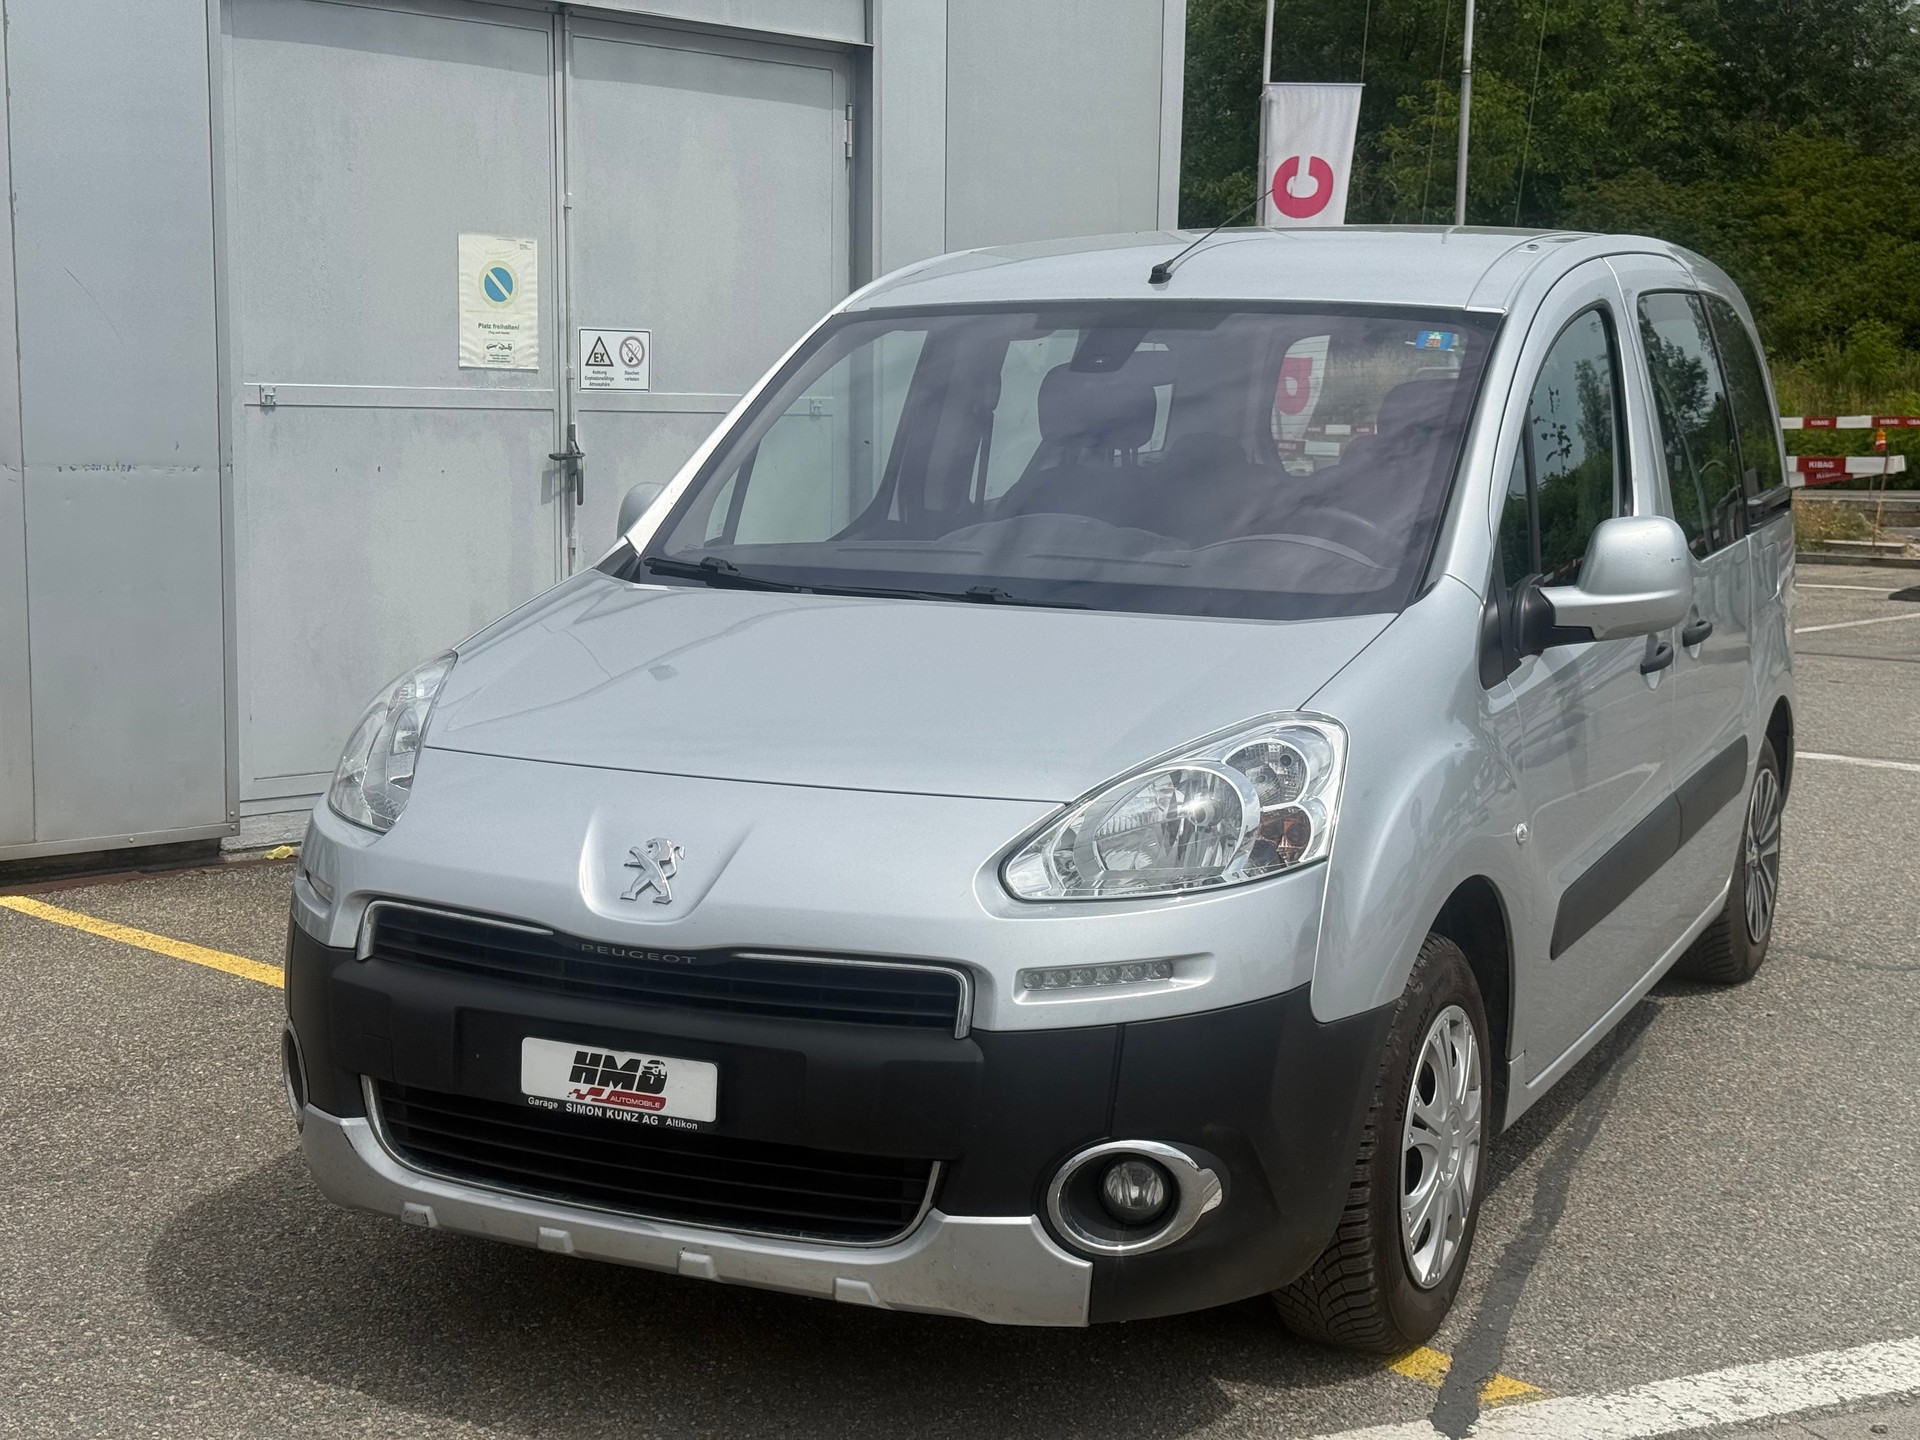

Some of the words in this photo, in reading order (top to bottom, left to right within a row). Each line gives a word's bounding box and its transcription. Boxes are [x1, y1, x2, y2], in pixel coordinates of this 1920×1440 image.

[492, 323, 520, 331] freihalten!
[593, 352, 605, 363] EX
[581, 943, 697, 964] PEUGEOT
[610, 1095, 661, 1109] AUTOMOBILE
[528, 1096, 558, 1109] Garage
[565, 1102, 602, 1117] SIMON
[606, 1109, 639, 1123] KUNZ
[642, 1114, 659, 1125] AG
[665, 1117, 698, 1130] Altikon
